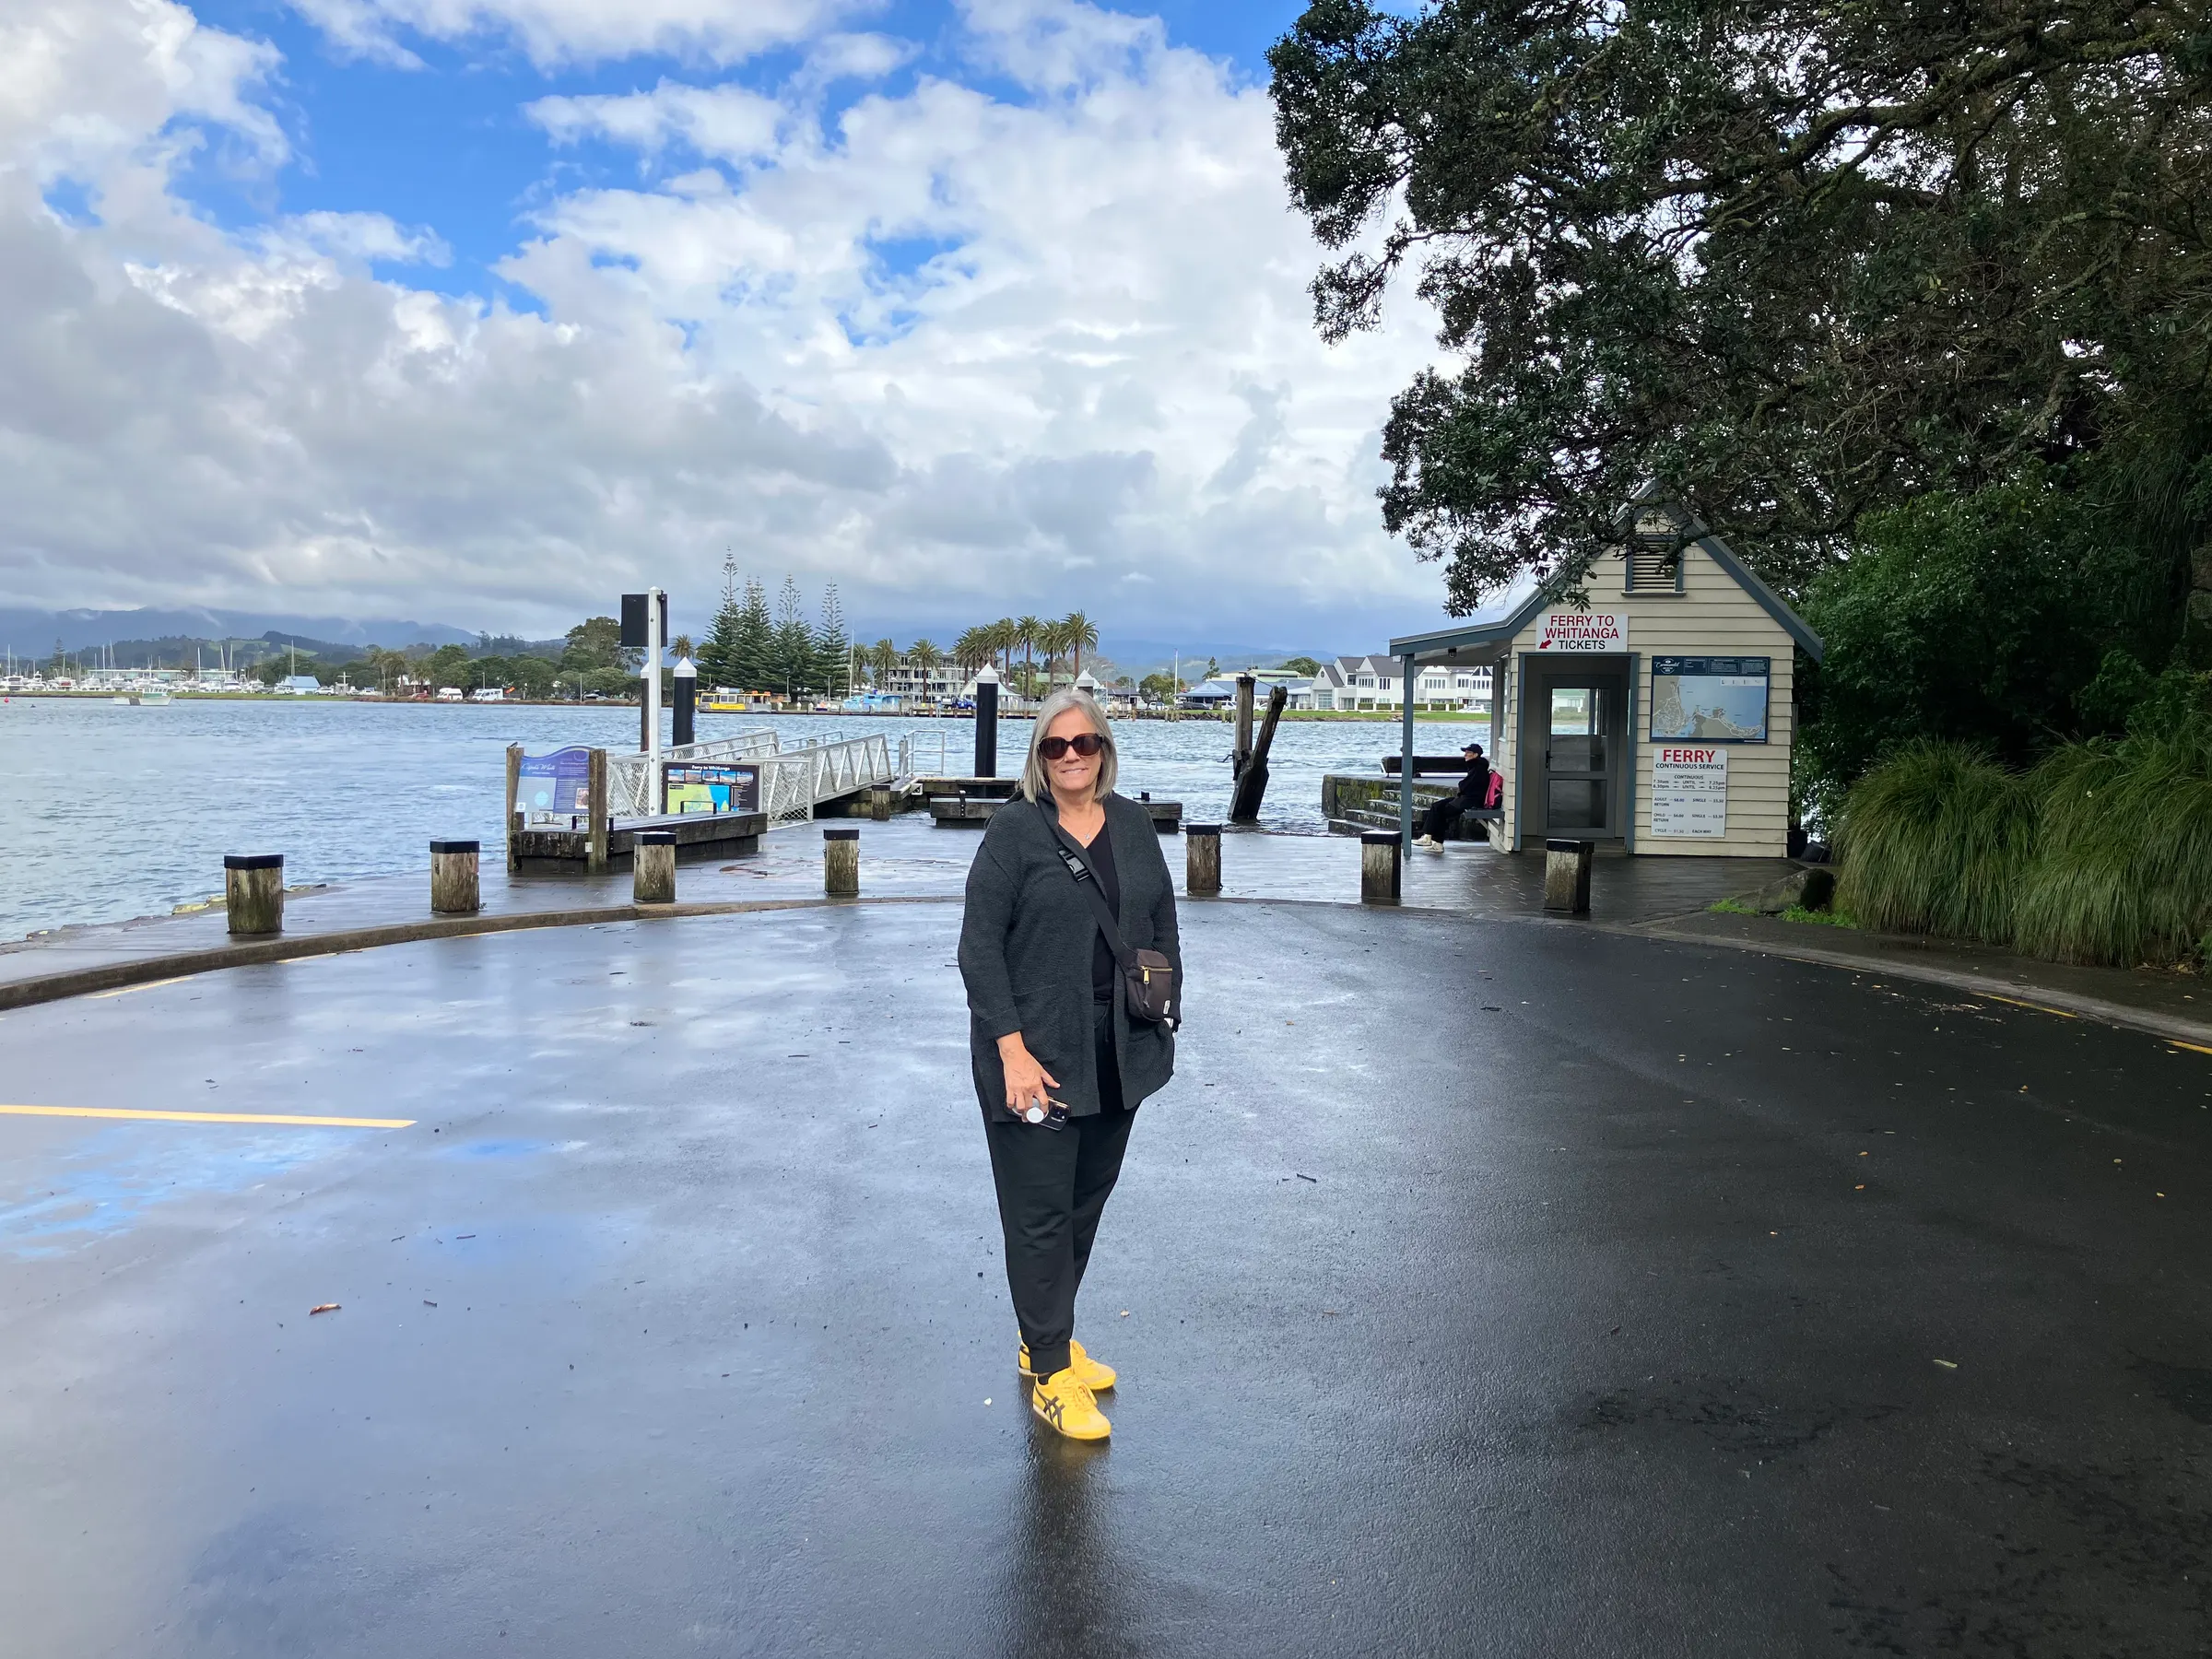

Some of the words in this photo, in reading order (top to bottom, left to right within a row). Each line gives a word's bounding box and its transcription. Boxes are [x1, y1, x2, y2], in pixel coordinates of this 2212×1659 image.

[1550, 615, 1593, 627] FERRY
[1596, 615, 1615, 627] TO
[1545, 628, 1619, 639] WHITIANGA
[1559, 640, 1606, 650] TICKETS
[1663, 749, 1716, 763] FERRY
